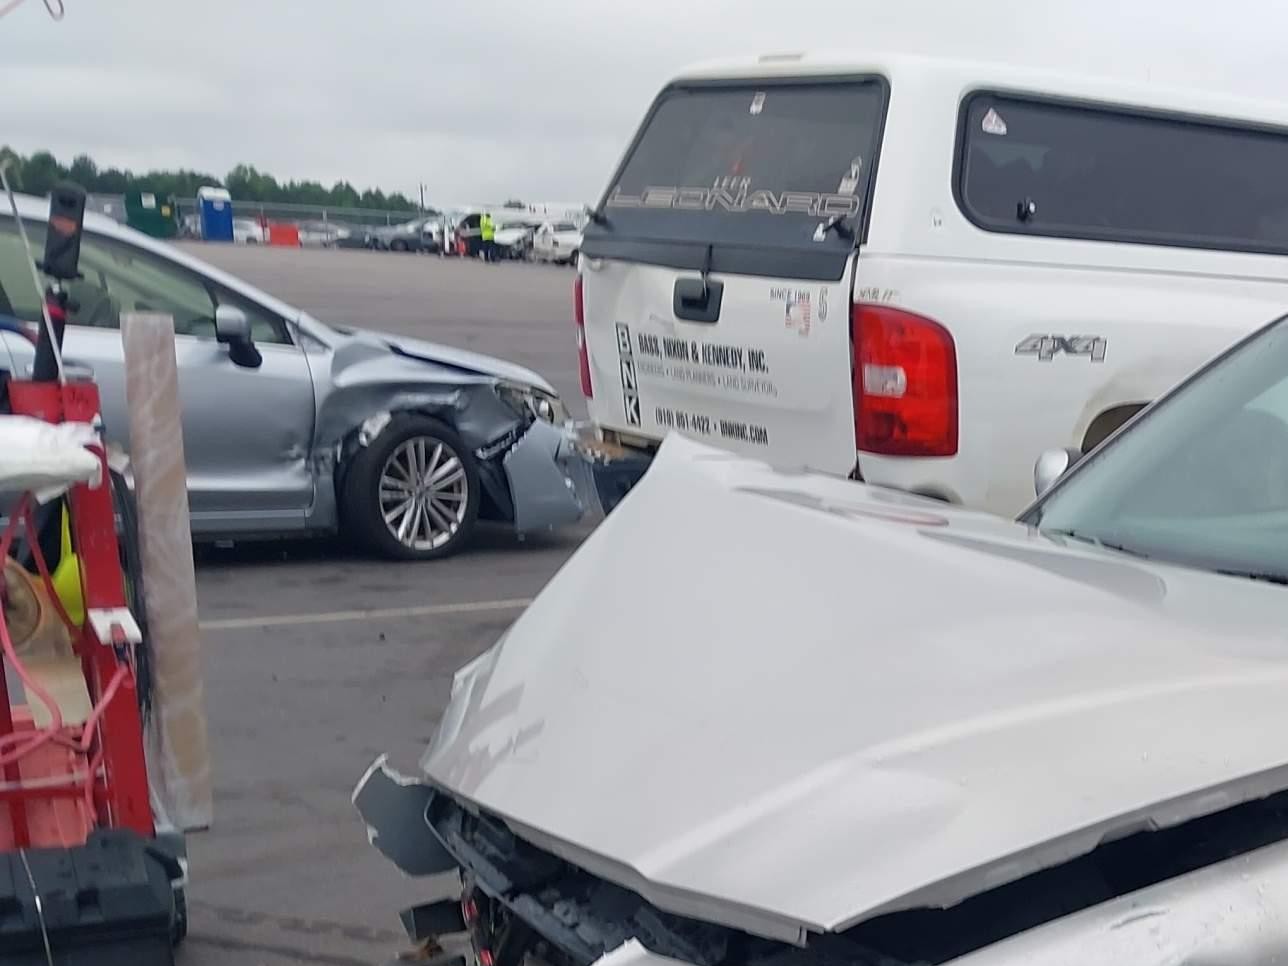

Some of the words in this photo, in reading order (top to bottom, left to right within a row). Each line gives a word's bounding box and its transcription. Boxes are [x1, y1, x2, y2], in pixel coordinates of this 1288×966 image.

[606, 185, 861, 217] LEONARD
[663, 337, 690, 362] NIXON
[691, 341, 700, 362] &
[701, 343, 746, 374] KENNEDY,
[748, 349, 769, 374] INC.
